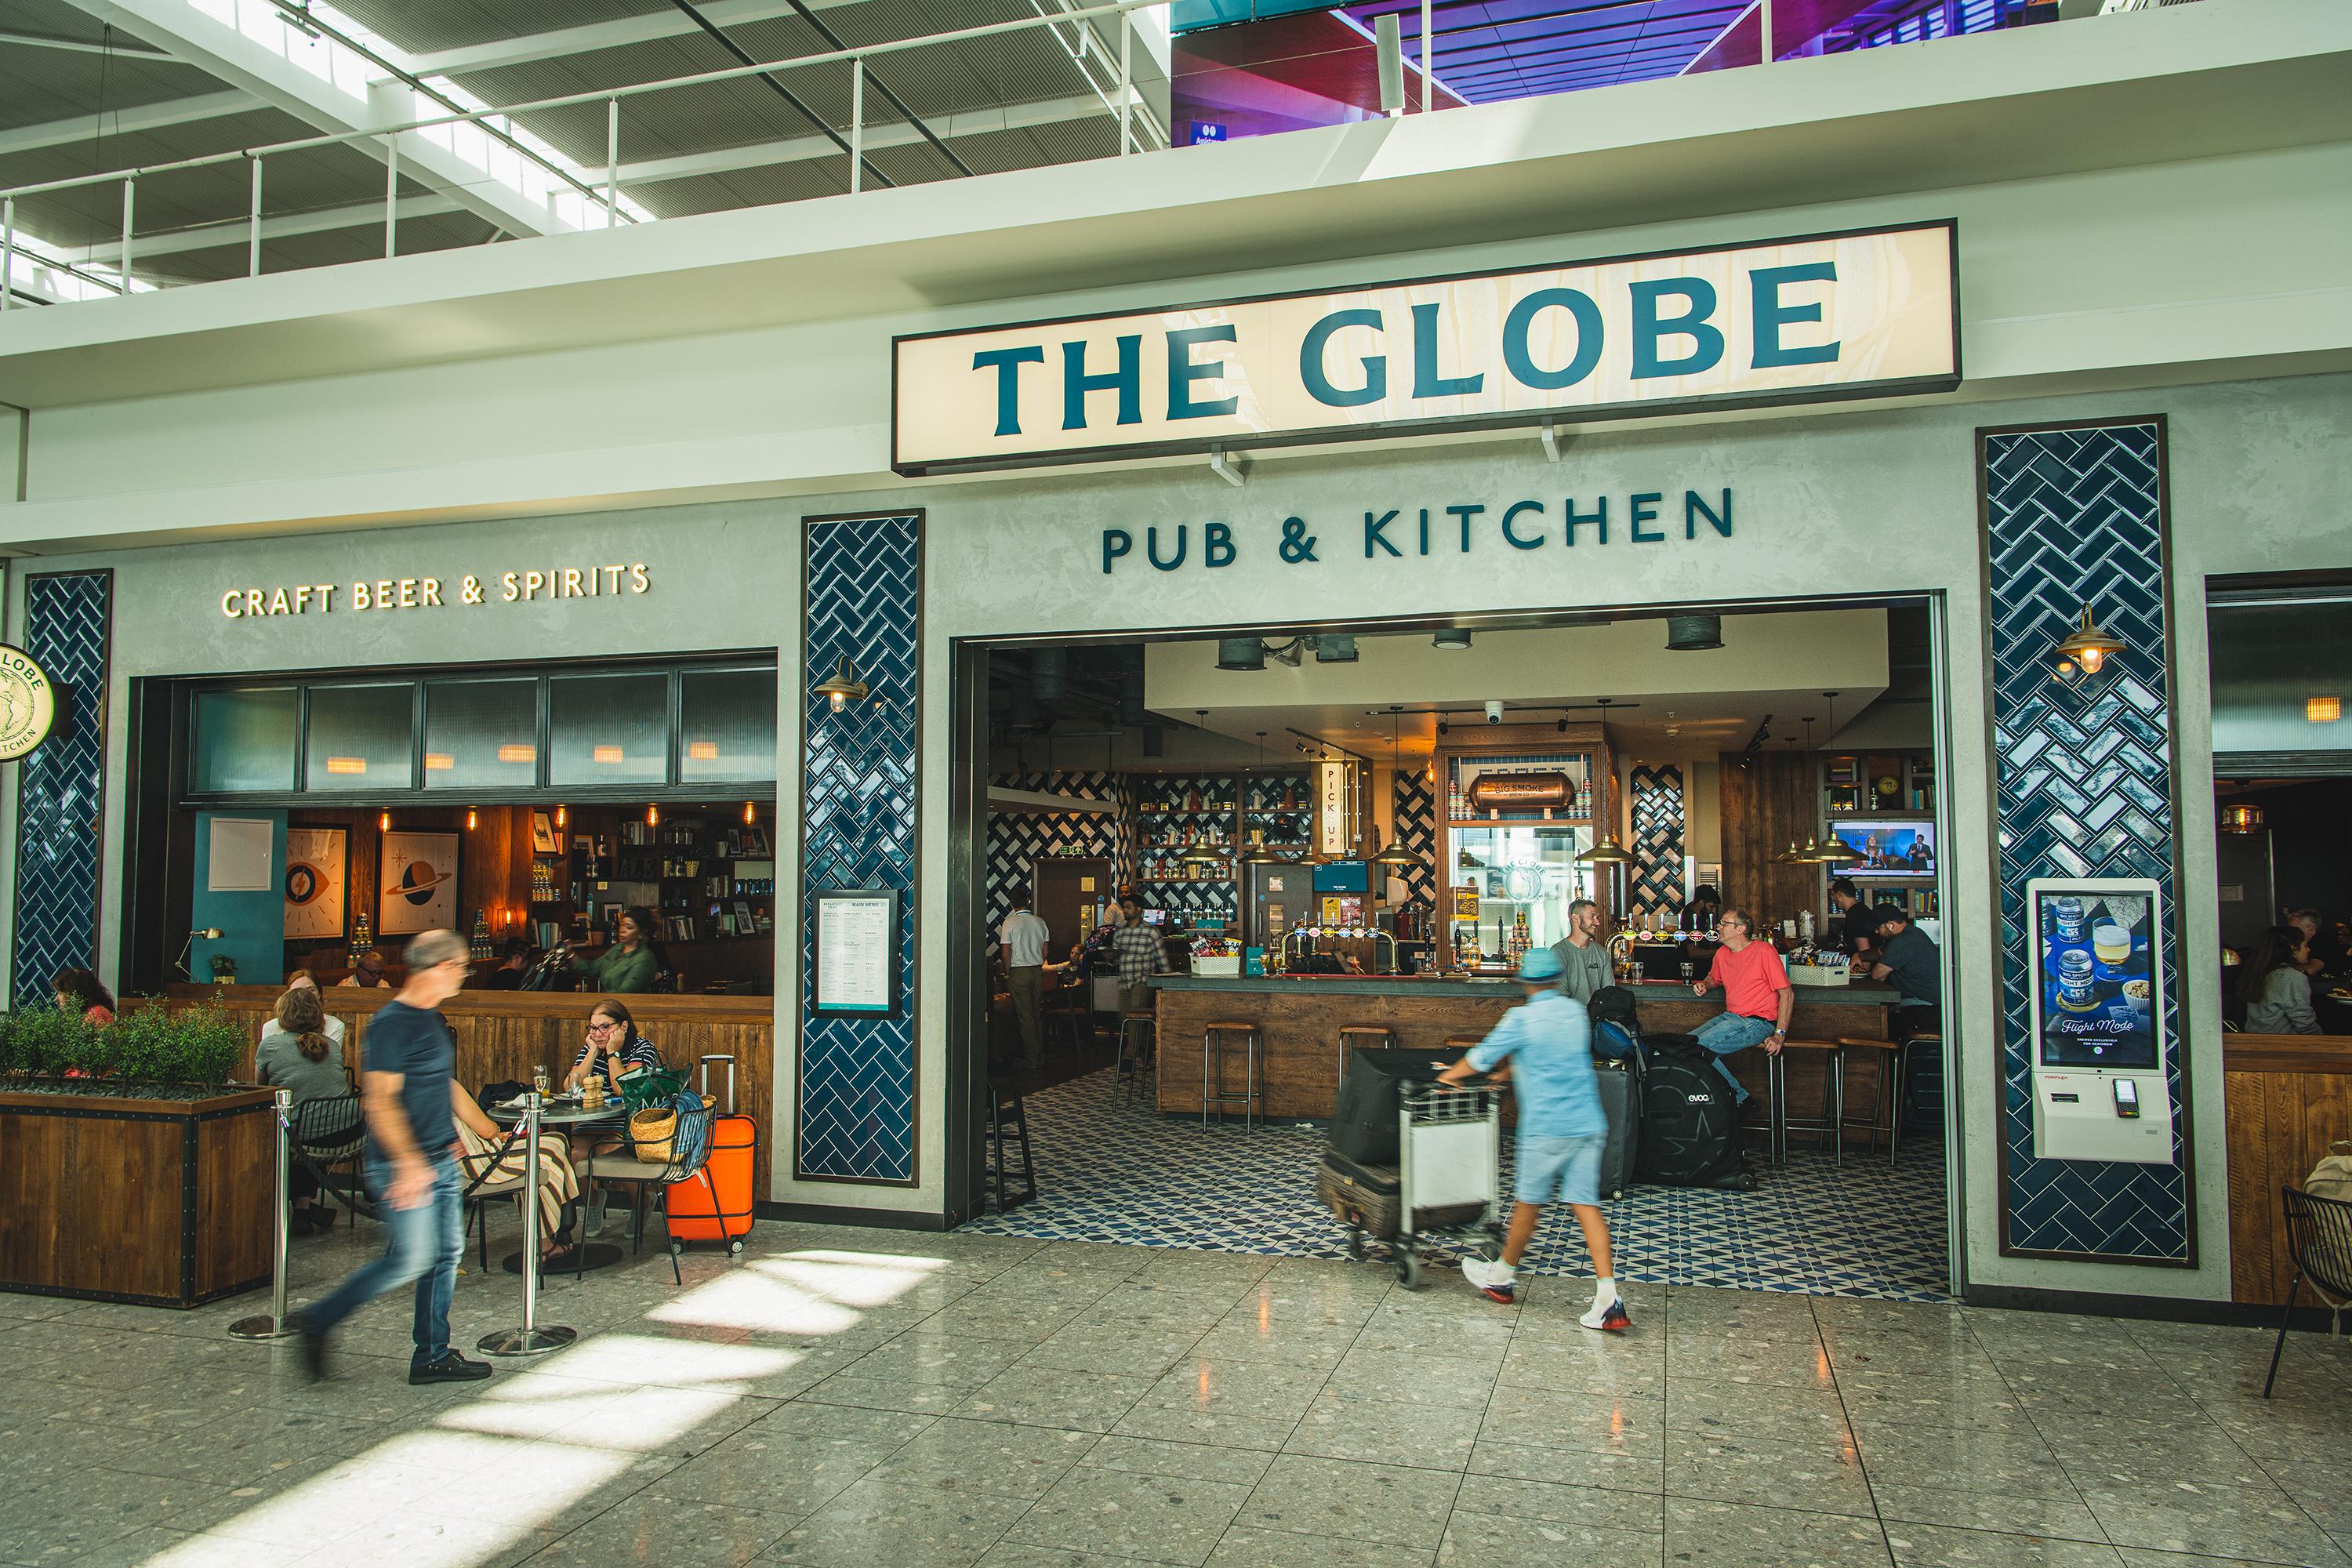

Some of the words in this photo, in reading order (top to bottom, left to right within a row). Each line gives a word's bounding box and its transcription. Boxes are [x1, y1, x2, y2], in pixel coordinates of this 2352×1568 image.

[972, 324, 1239, 437] THE
[1300, 261, 1841, 408] GLOBE
[1102, 521, 1236, 574] PUB
[1279, 516, 1319, 564] &
[1364, 488, 1732, 560] KITCHEN
[221, 584, 337, 618] CRAFT
[353, 577, 445, 611] BEER
[461, 575, 485, 605] &
[502, 562, 652, 602] SPIRITS
[2, 653, 44, 691] LOBE
[0, 728, 36, 753] TCHEN
[1328, 827, 1335, 845] UP
[1501, 861, 1516, 875] THE
[2061, 1019, 2095, 1034] Flight
[2096, 1019, 2134, 1033] Mode
